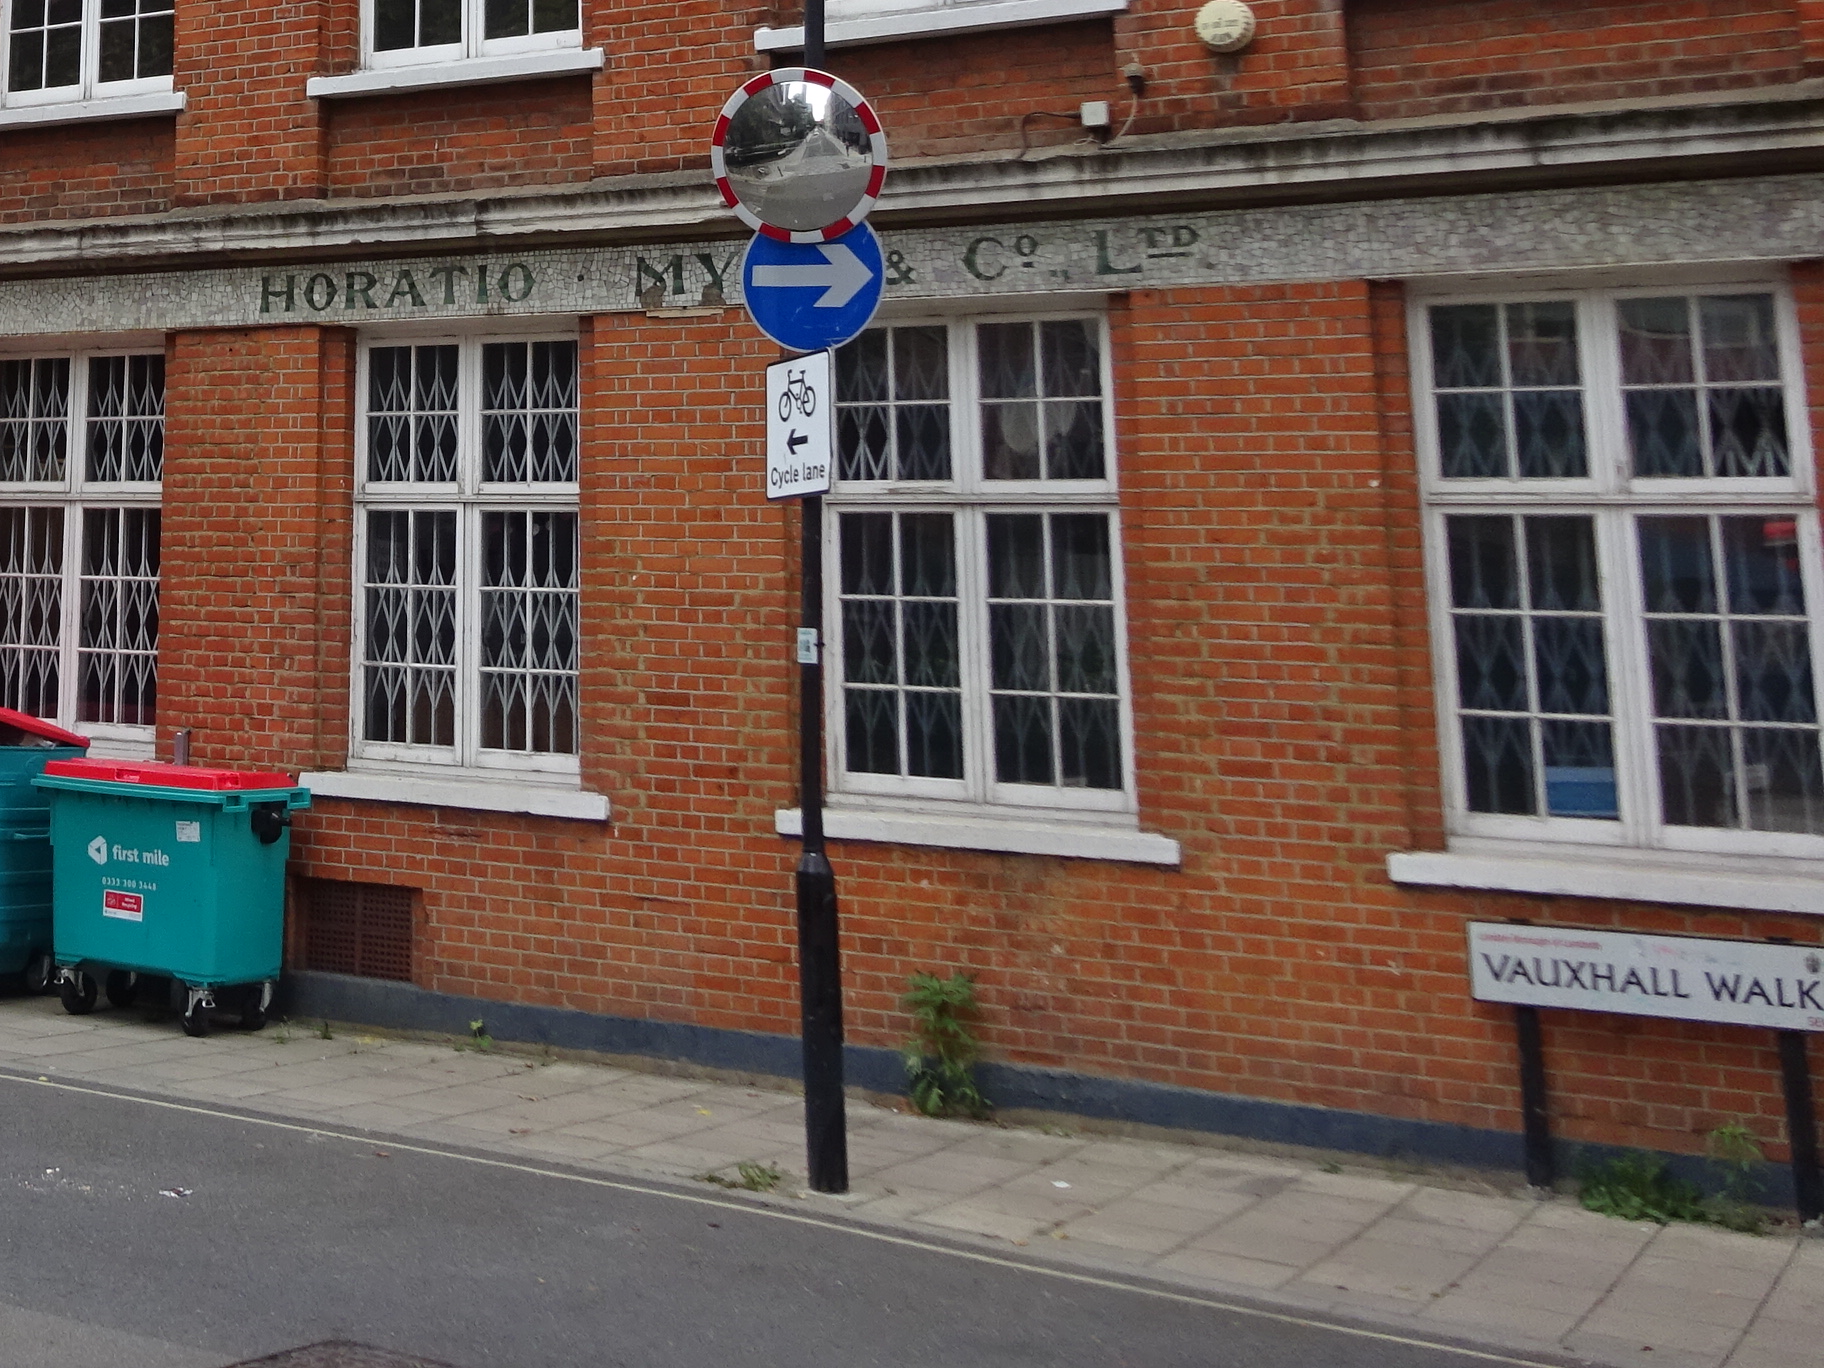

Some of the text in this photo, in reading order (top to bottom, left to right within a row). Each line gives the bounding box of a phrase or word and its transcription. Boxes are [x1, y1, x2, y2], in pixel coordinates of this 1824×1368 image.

[259, 262, 537, 314] HORATIO
[770, 462, 826, 489] Cycle lane
[112, 843, 170, 867] first mile
[101, 876, 121, 887] 0333
[1480, 952, 1824, 1011] VAUXHALL WALK
